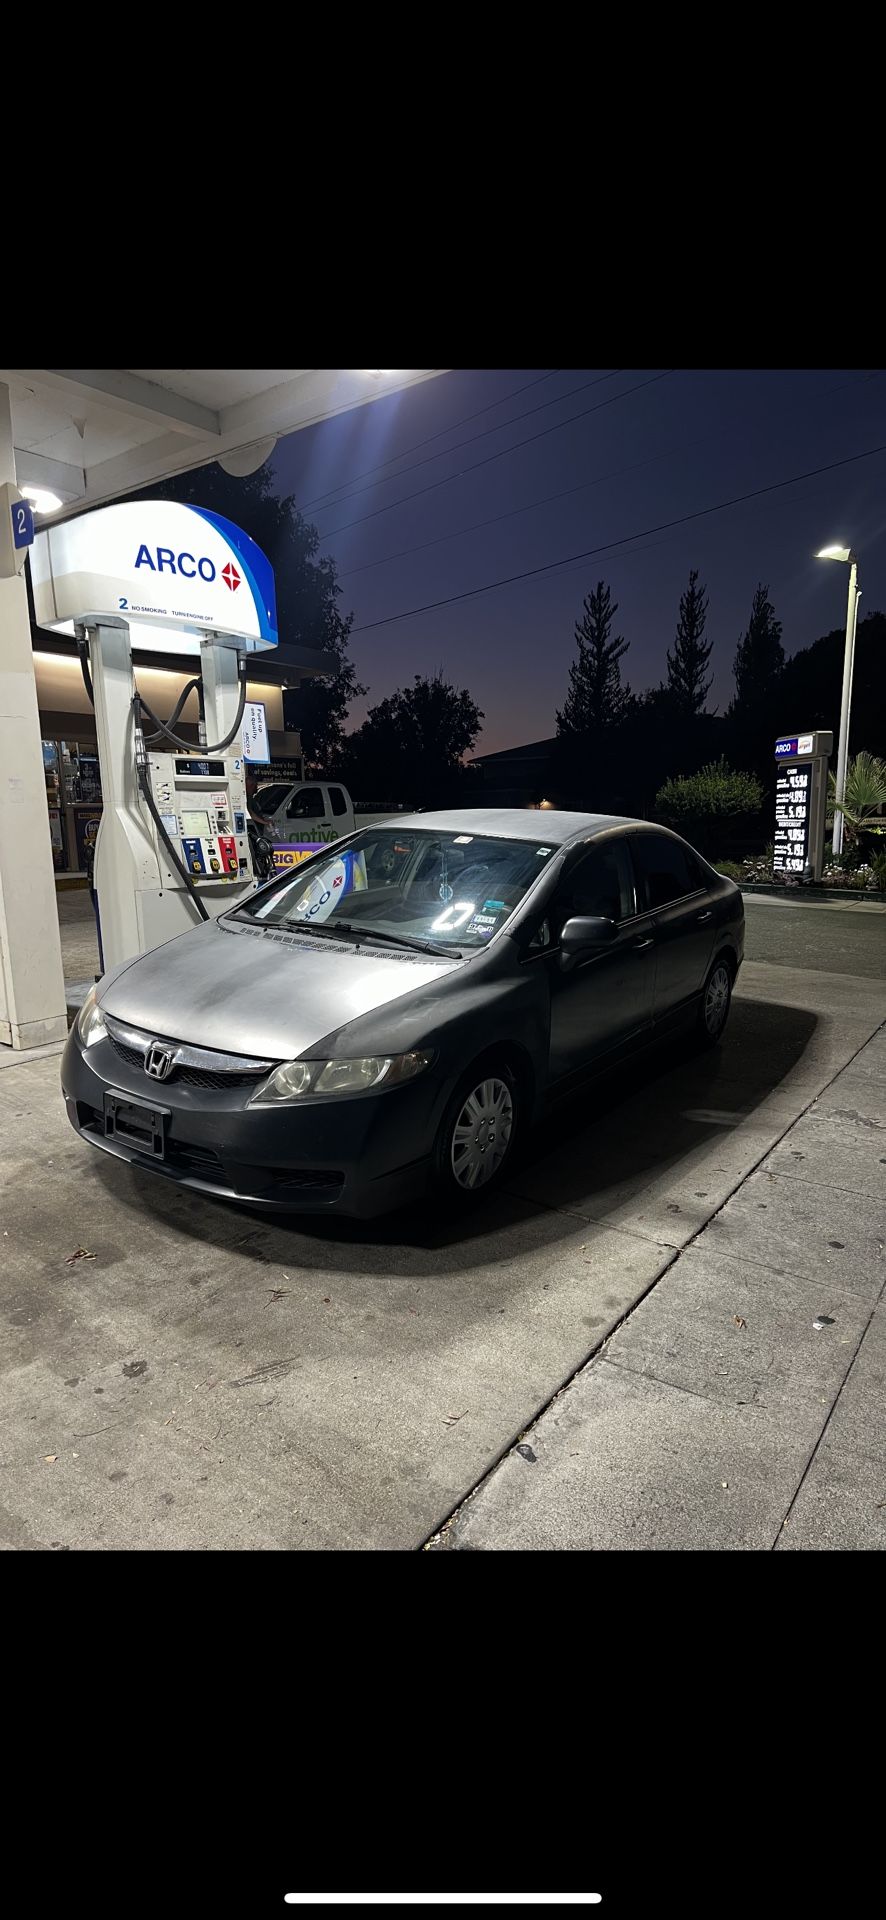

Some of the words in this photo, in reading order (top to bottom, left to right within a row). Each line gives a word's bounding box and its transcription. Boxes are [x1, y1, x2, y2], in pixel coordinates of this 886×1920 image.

[16, 508, 27, 535] 2
[134, 544, 217, 583] ARCO
[118, 597, 129, 610] 2
[141, 607, 167, 615] SMOKING
[257, 724, 263, 733] up
[775, 743, 791, 754] ARCO
[234, 759, 241, 770] 2
[288, 827, 338, 843] aptive
[272, 853, 294, 864] BIG
